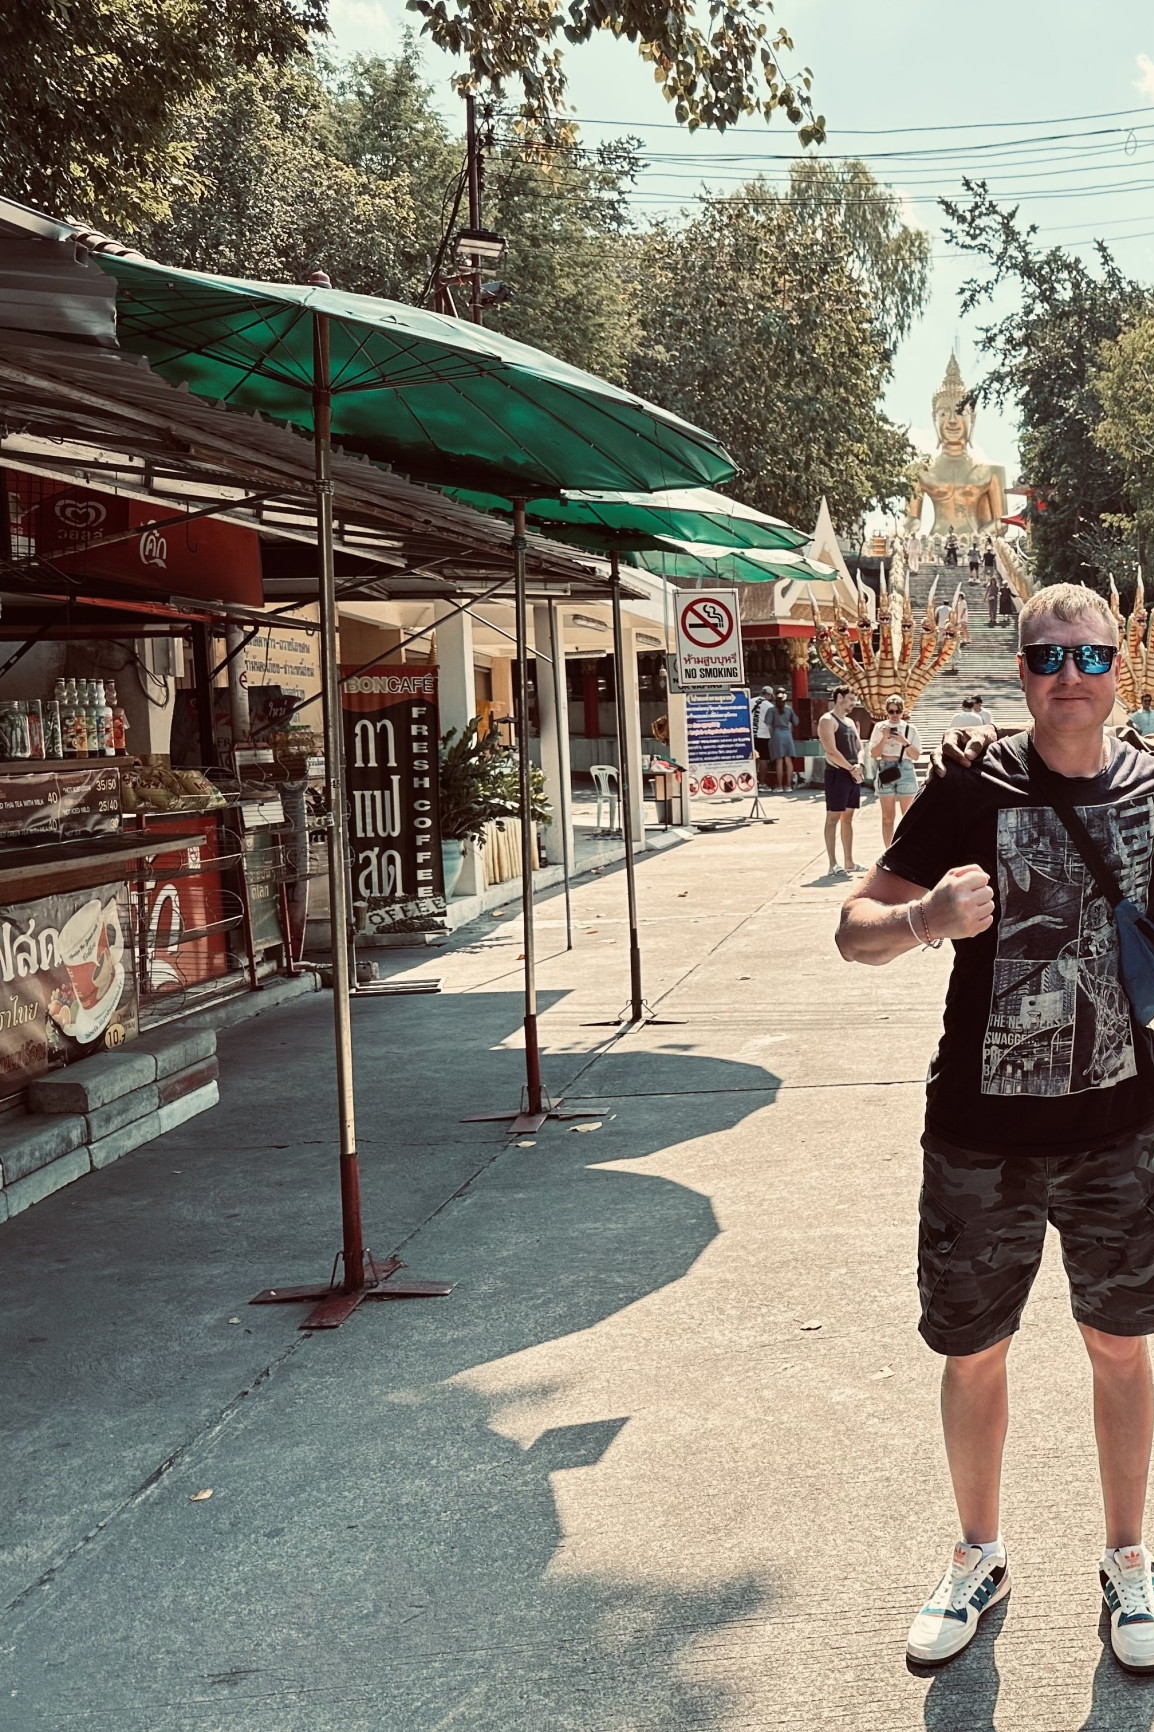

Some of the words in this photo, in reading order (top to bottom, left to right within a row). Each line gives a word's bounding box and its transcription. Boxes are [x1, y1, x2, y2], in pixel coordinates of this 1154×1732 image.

[685, 668, 697, 678] NO
[700, 667, 738, 678] SMOKING
[344, 673, 434, 694] BONCAFÉ
[411, 706, 430, 788] FRESH
[48, 792, 58, 804] 40
[413, 800, 434, 898] COFFEE
[990, 1014, 1006, 1028] THE
